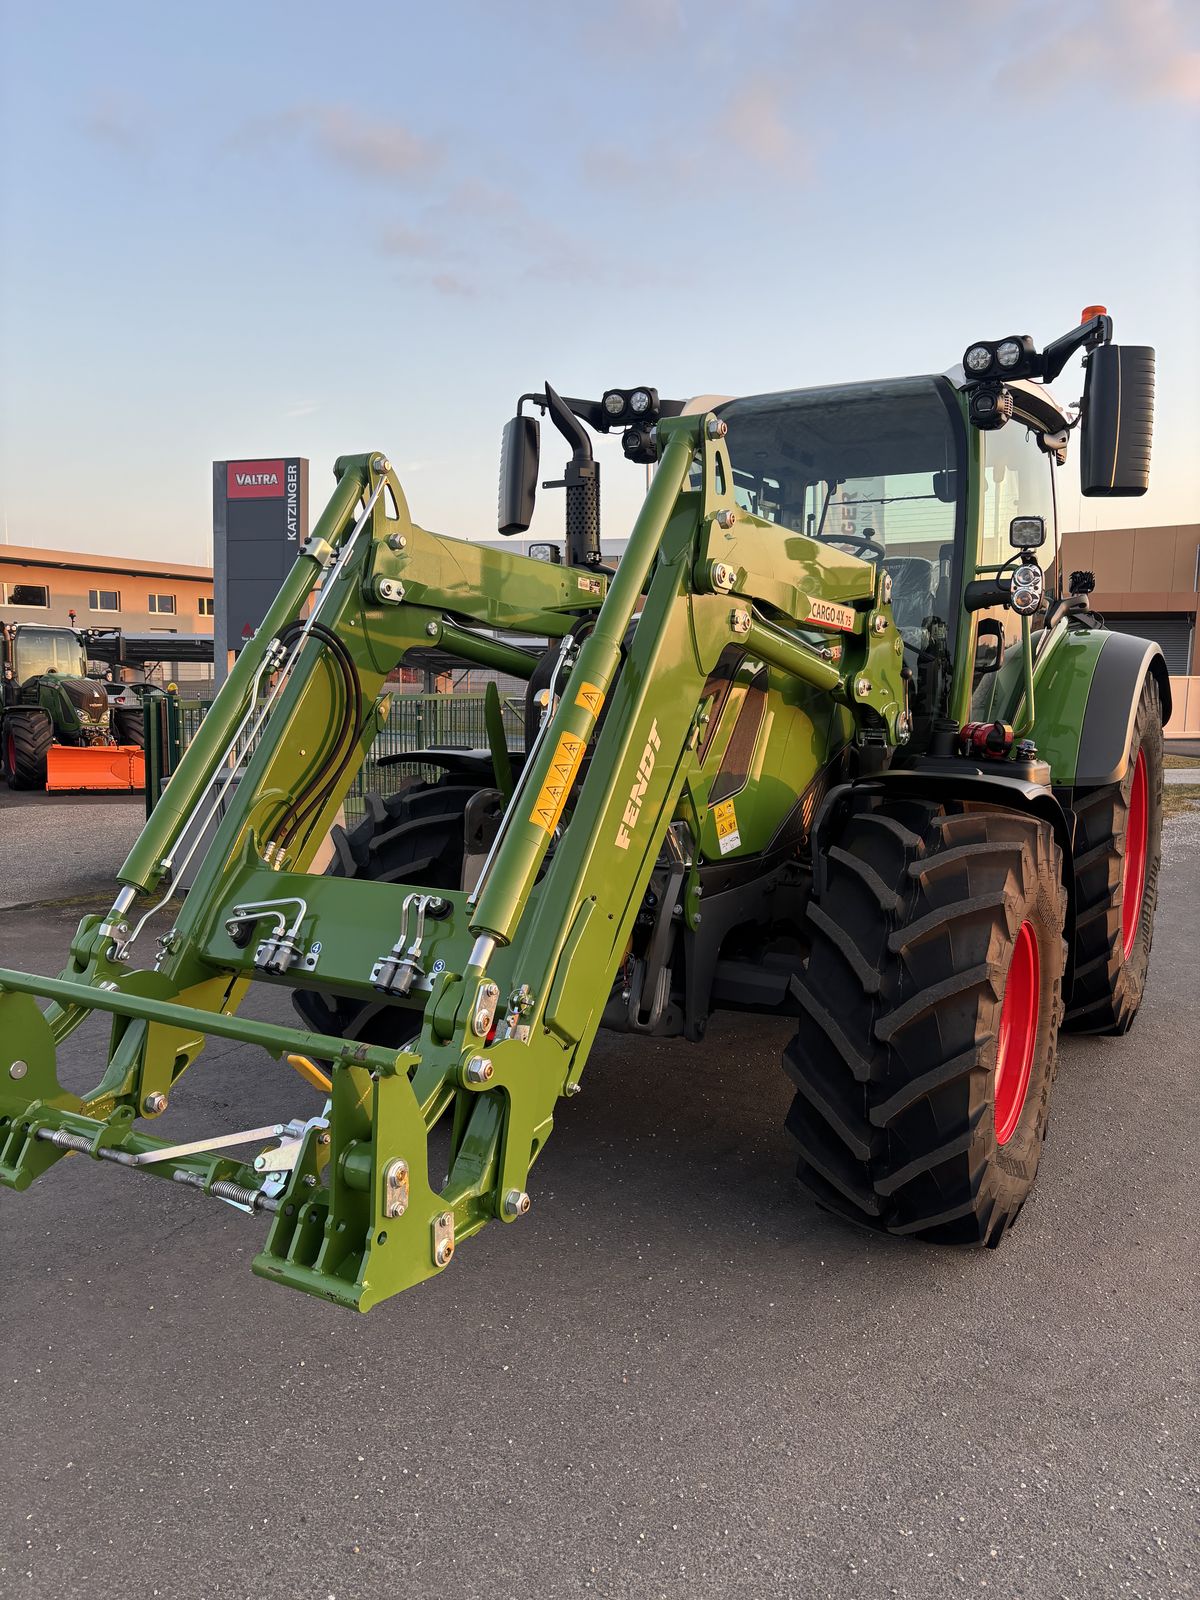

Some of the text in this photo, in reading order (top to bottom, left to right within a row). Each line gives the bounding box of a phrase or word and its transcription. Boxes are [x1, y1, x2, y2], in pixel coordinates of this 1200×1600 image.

[236, 474, 278, 485] VALTRA
[287, 465, 297, 540] KATZINGER
[812, 602, 836, 622] CARGO
[614, 718, 662, 850] FENDT
